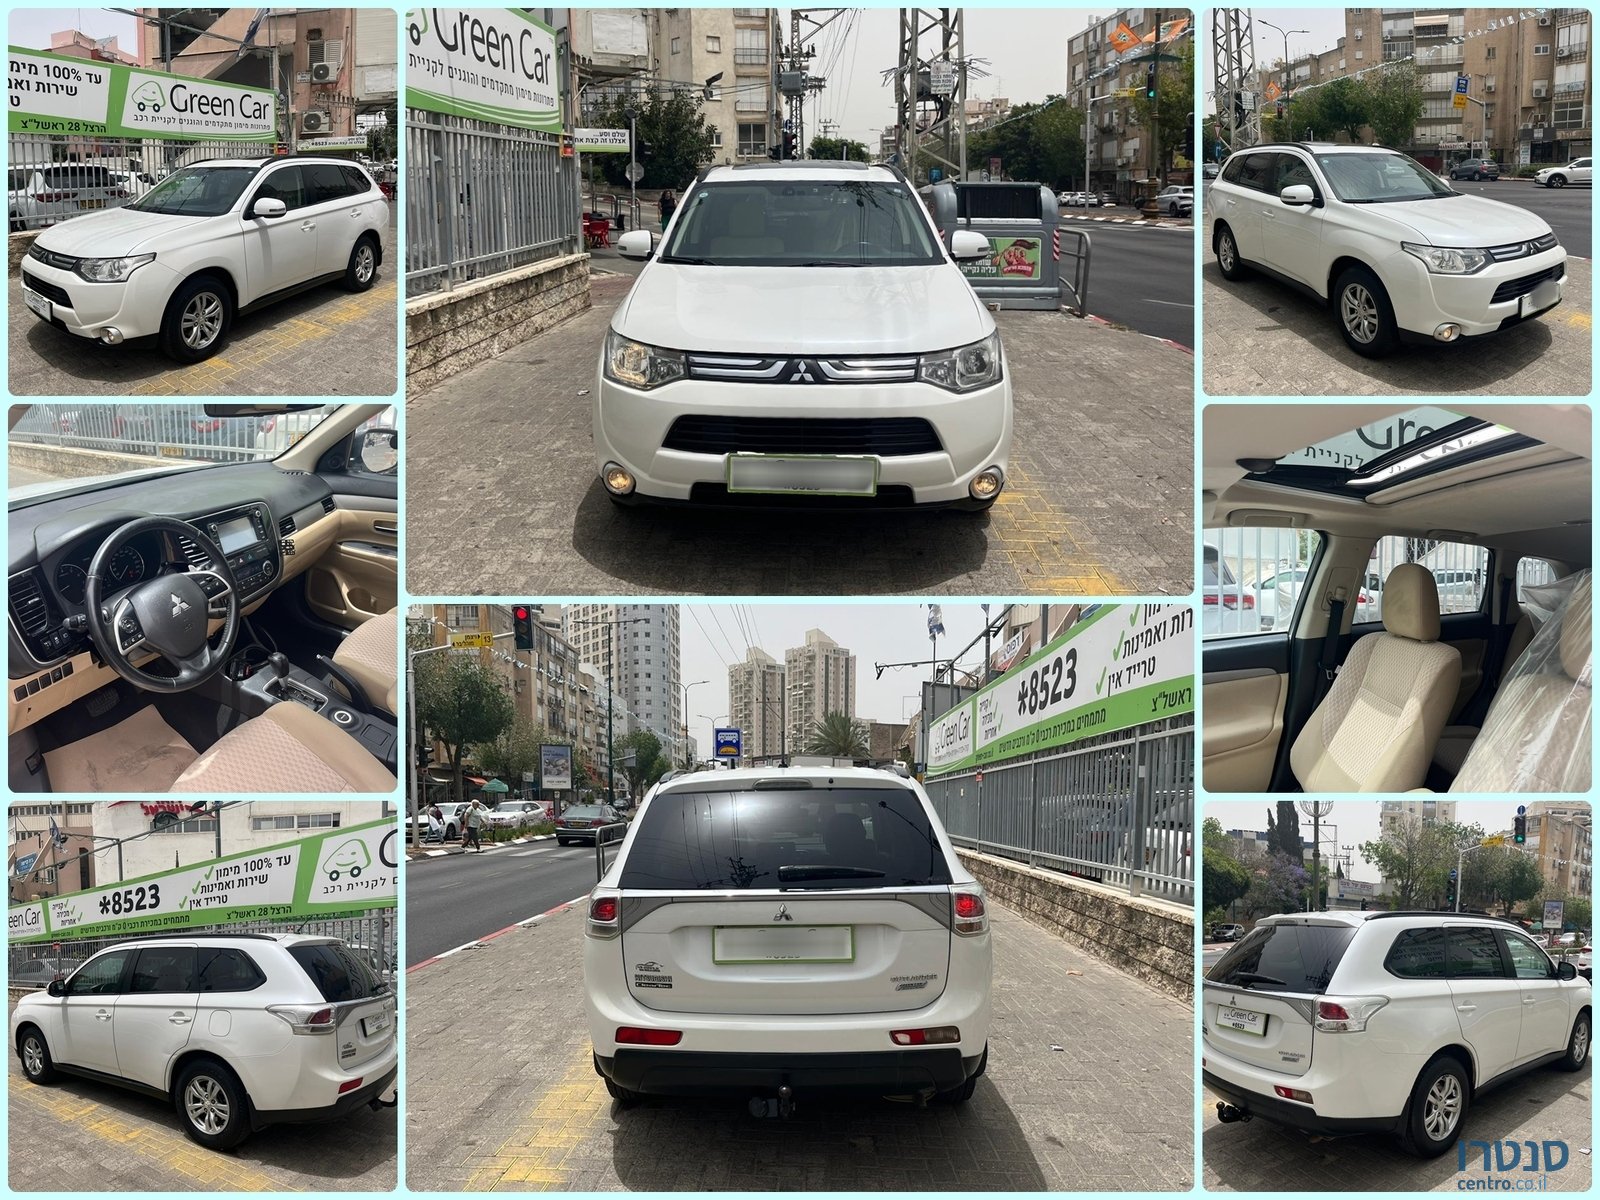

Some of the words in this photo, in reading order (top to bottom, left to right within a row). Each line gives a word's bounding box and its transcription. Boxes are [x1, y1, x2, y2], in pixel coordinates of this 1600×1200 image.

[519, 28, 551, 86] Car
[409, 53, 444, 77] לקניית
[44, 64, 82, 82] 100%
[85, 72, 102, 85] עד
[447, 65, 479, 86] והוגנים
[35, 80, 78, 97] שירות
[481, 76, 514, 97] מתקדמים
[169, 83, 235, 117] Green
[239, 93, 270, 121] Car
[133, 114, 149, 122] רכב
[150, 115, 176, 126] לקניית
[67, 121, 81, 132] 28
[82, 122, 107, 133] הרצל
[483, 635, 491, 643] 13
[1122, 620, 1167, 660] ואמינות
[1125, 655, 1156, 685] טרייד
[1107, 672, 1123, 698] אין
[1076, 707, 1107, 730] מתמחים
[1052, 718, 1076, 738] במכירת
[243, 857, 273, 873] 100%
[275, 854, 292, 868] עד
[215, 864, 241, 882] מימון
[200, 881, 235, 895] ואמינות
[237, 873, 269, 889] שירות
[346, 876, 387, 891] לקניית
[323, 884, 342, 895] רכב
[189, 898, 202, 911] אין
[203, 894, 228, 906] טרייד
[25, 907, 41, 926] Car
[257, 907, 269, 916] 28
[270, 905, 292, 916] הרצל
[126, 921, 140, 929] רכבי
[140, 918, 162, 928] במכירת
[163, 914, 190, 925] מתמחים
[1230, 1008, 1247, 1020] Green
[1247, 1012, 1258, 1022] Car
